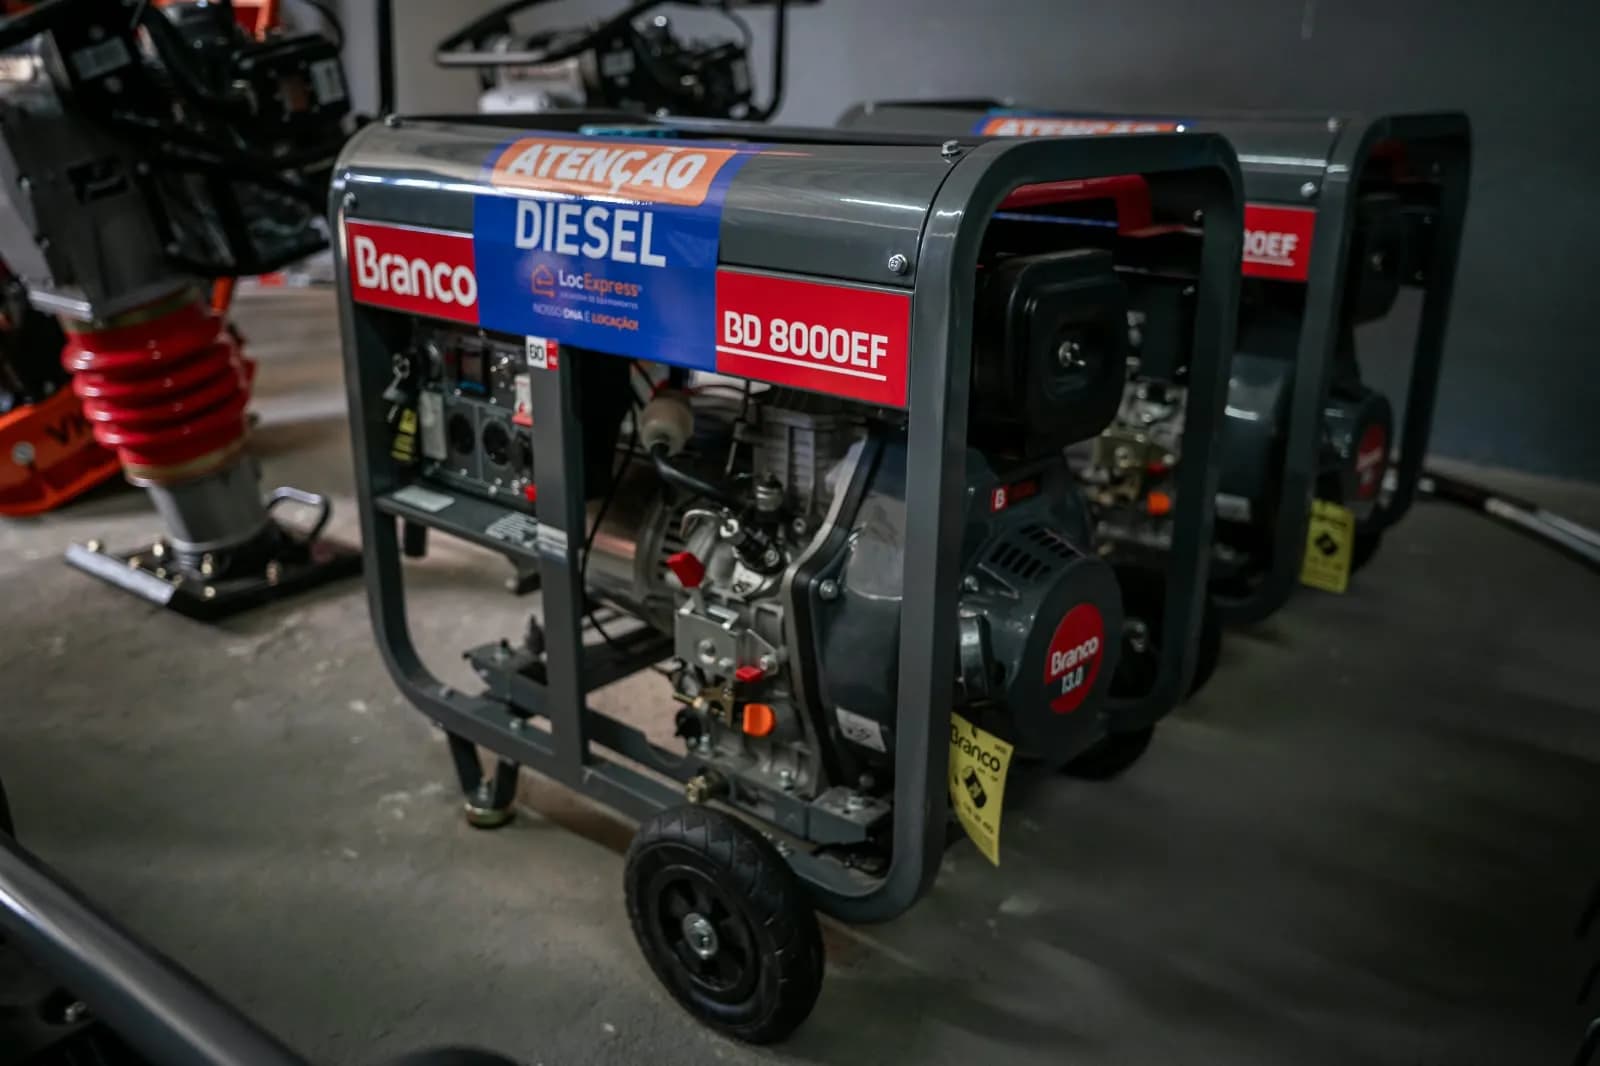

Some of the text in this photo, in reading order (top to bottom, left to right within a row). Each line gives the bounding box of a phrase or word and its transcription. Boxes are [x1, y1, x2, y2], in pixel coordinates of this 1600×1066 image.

[505, 142, 708, 194] ATENÇÃO
[514, 199, 667, 268] DIESEL
[353, 235, 478, 308] Branco
[558, 269, 640, 298] LocExpress
[724, 310, 889, 369] BD 8000EF
[1050, 636, 1099, 676] Branco
